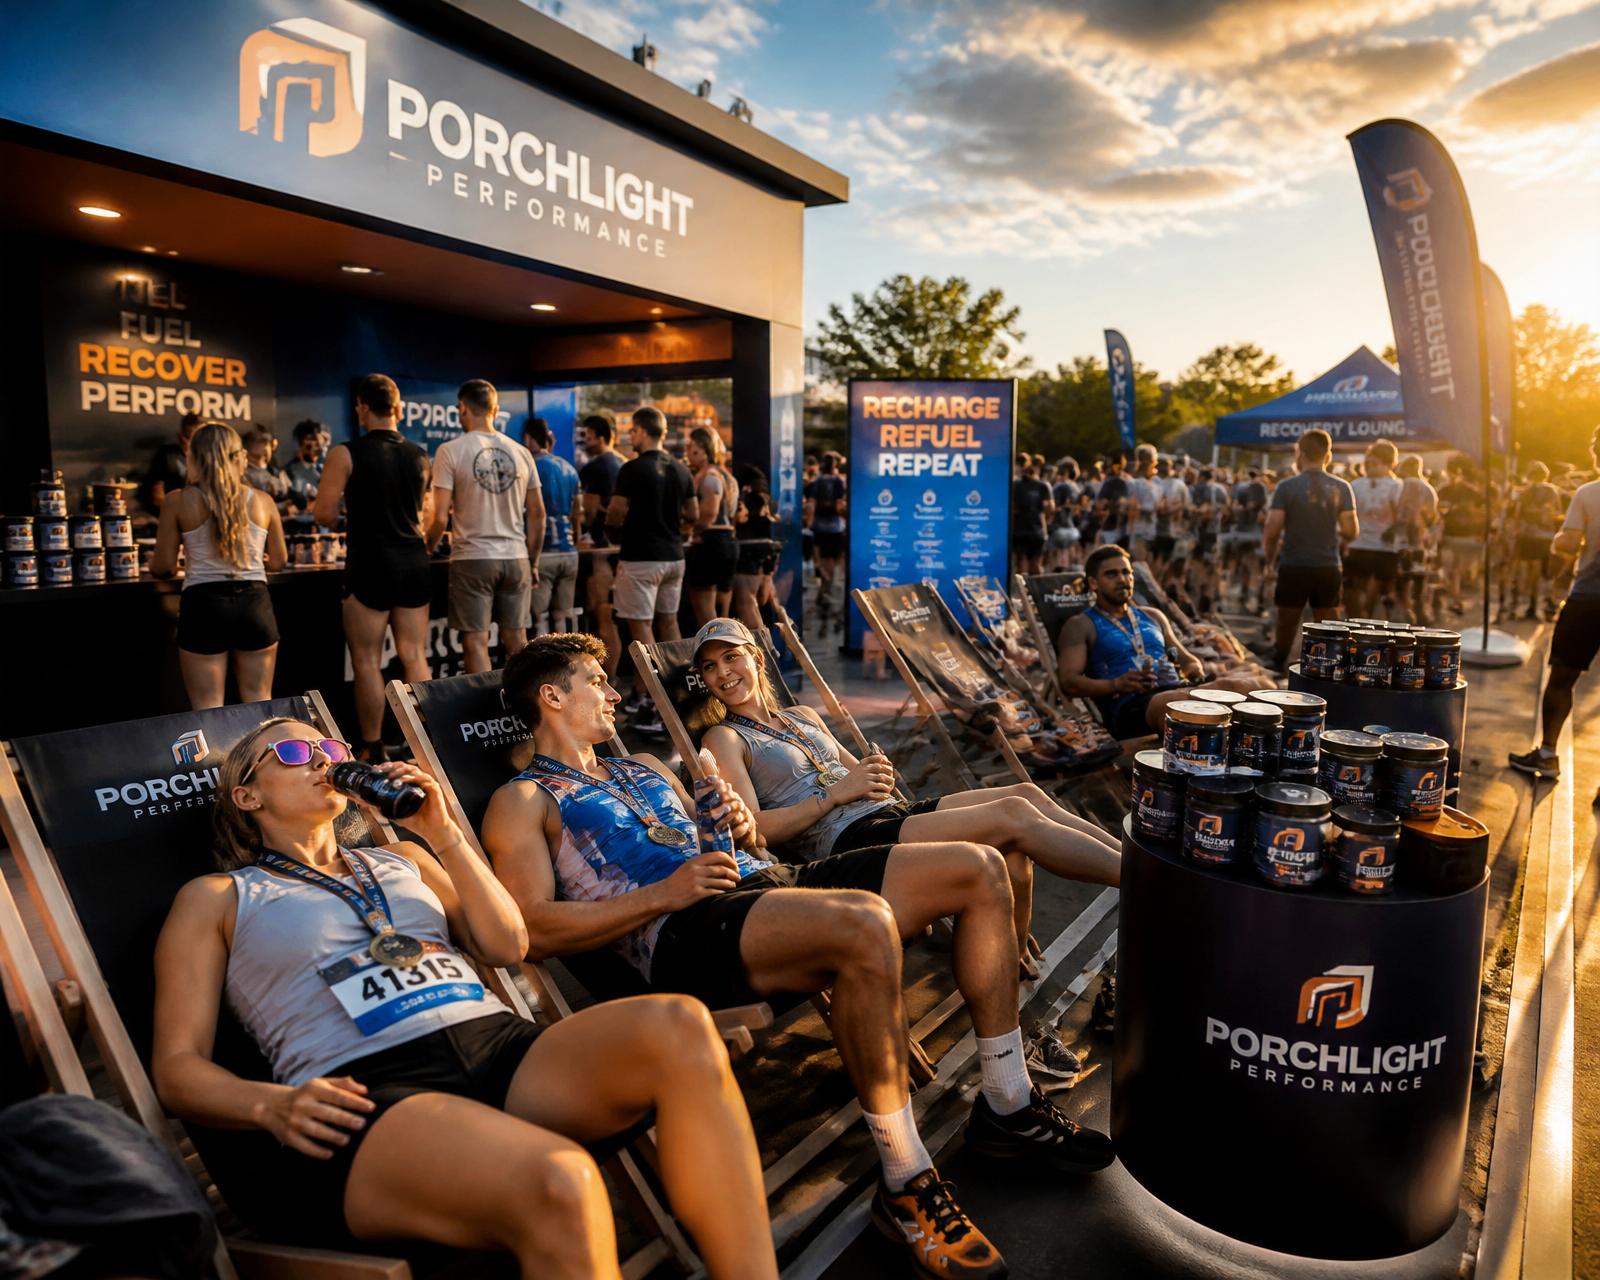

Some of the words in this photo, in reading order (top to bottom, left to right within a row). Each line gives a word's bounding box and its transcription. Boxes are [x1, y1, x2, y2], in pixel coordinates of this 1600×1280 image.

[387, 79, 694, 237] PORCHLIGHT
[426, 164, 666, 258] PERFORMANCE
[120, 310, 202, 349] FUEL
[78, 342, 247, 388] RECOVER
[79, 380, 251, 421] PERFORM
[863, 396, 1001, 420] RECHARGE
[880, 424, 982, 449] REFUEL
[1348, 419, 1416, 437] LOUNG
[878, 453, 983, 478] REPEAT
[362, 957, 463, 1001] 41315
[1205, 1015, 1447, 1076] PORCHLIGHT
[1230, 1058, 1422, 1094] PERFORMANCE
